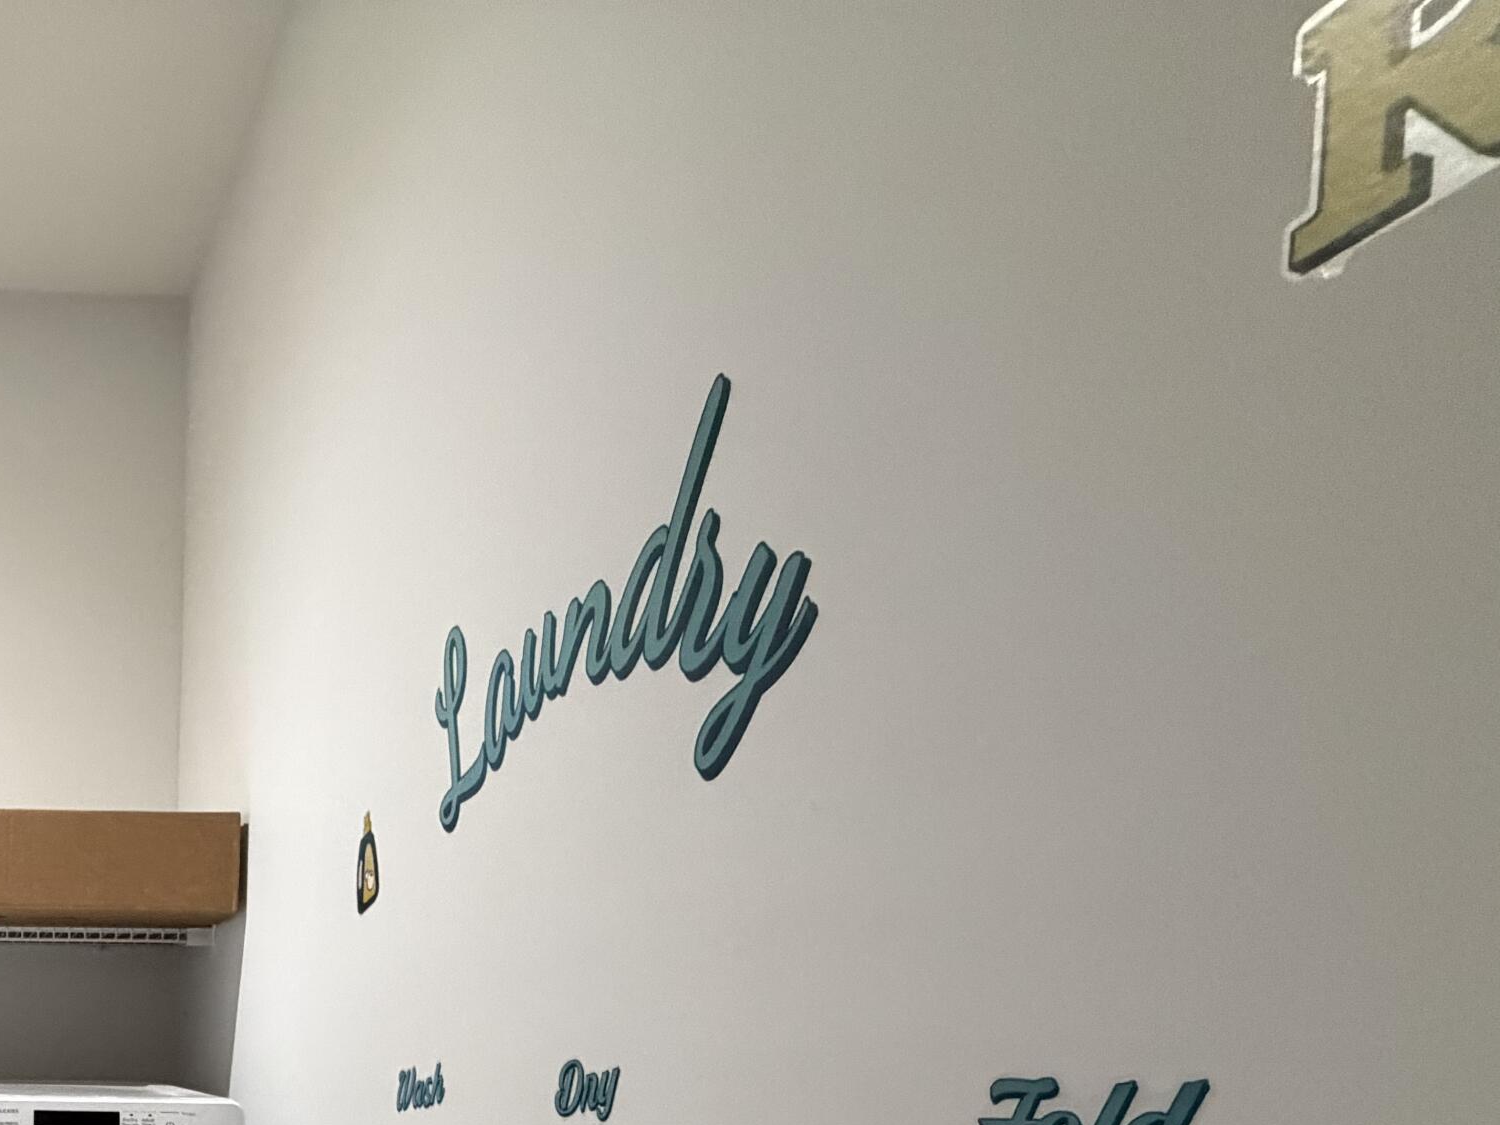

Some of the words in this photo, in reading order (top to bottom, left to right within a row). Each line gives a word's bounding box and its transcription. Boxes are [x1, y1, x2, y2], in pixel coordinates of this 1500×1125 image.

[435, 373, 818, 833] Laundry
[397, 1062, 446, 1112] Wash
[555, 1059, 621, 1122] Dry
